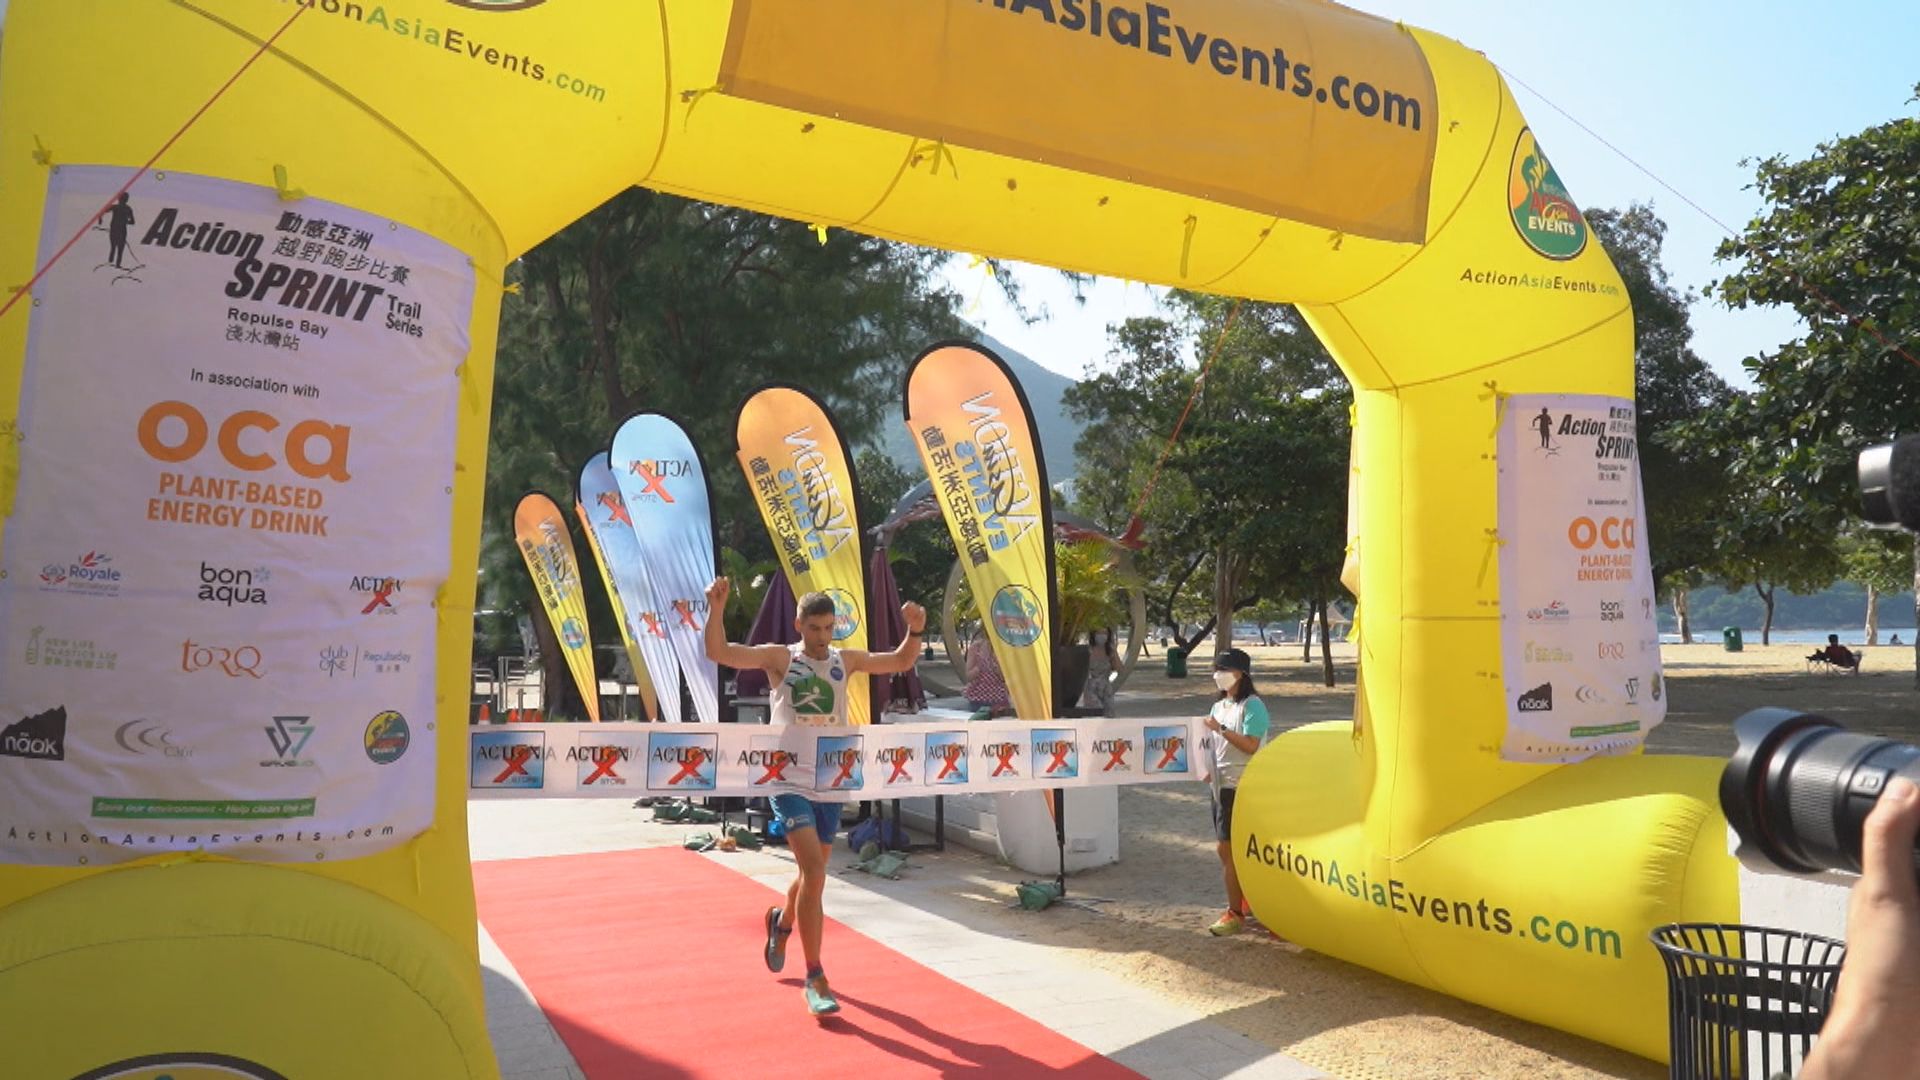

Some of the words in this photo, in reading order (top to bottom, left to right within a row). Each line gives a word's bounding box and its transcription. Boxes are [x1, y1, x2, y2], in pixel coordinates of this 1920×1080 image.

[280, 0, 607, 102] onAsiaEvents.com
[978, 0, 1422, 131] siaEvents.com
[141, 207, 265, 260] Action
[275, 210, 374, 251] 動感亞洲
[1528, 215, 1576, 236] EVENTS
[225, 257, 386, 322] SPRINT
[1460, 267, 1620, 297] ActionAsiaEvents.com
[387, 294, 422, 320] Trail
[227, 307, 294, 328] Repulse
[300, 319, 329, 339] Bay
[385, 311, 424, 338] Series
[190, 368, 204, 382] In
[208, 373, 288, 394] association
[293, 383, 320, 399] with
[137, 400, 352, 483] oca
[1557, 414, 1606, 438] Action
[159, 471, 324, 510] PLANT-BASED
[147, 498, 245, 528] ENERGY
[251, 508, 328, 537] DRINK
[69, 564, 121, 581] Royale
[200, 561, 252, 585] bon
[198, 584, 267, 607] aqua
[1600, 600, 1620, 611] bon
[1246, 832, 1622, 960] ActionAsiaEvents.com
